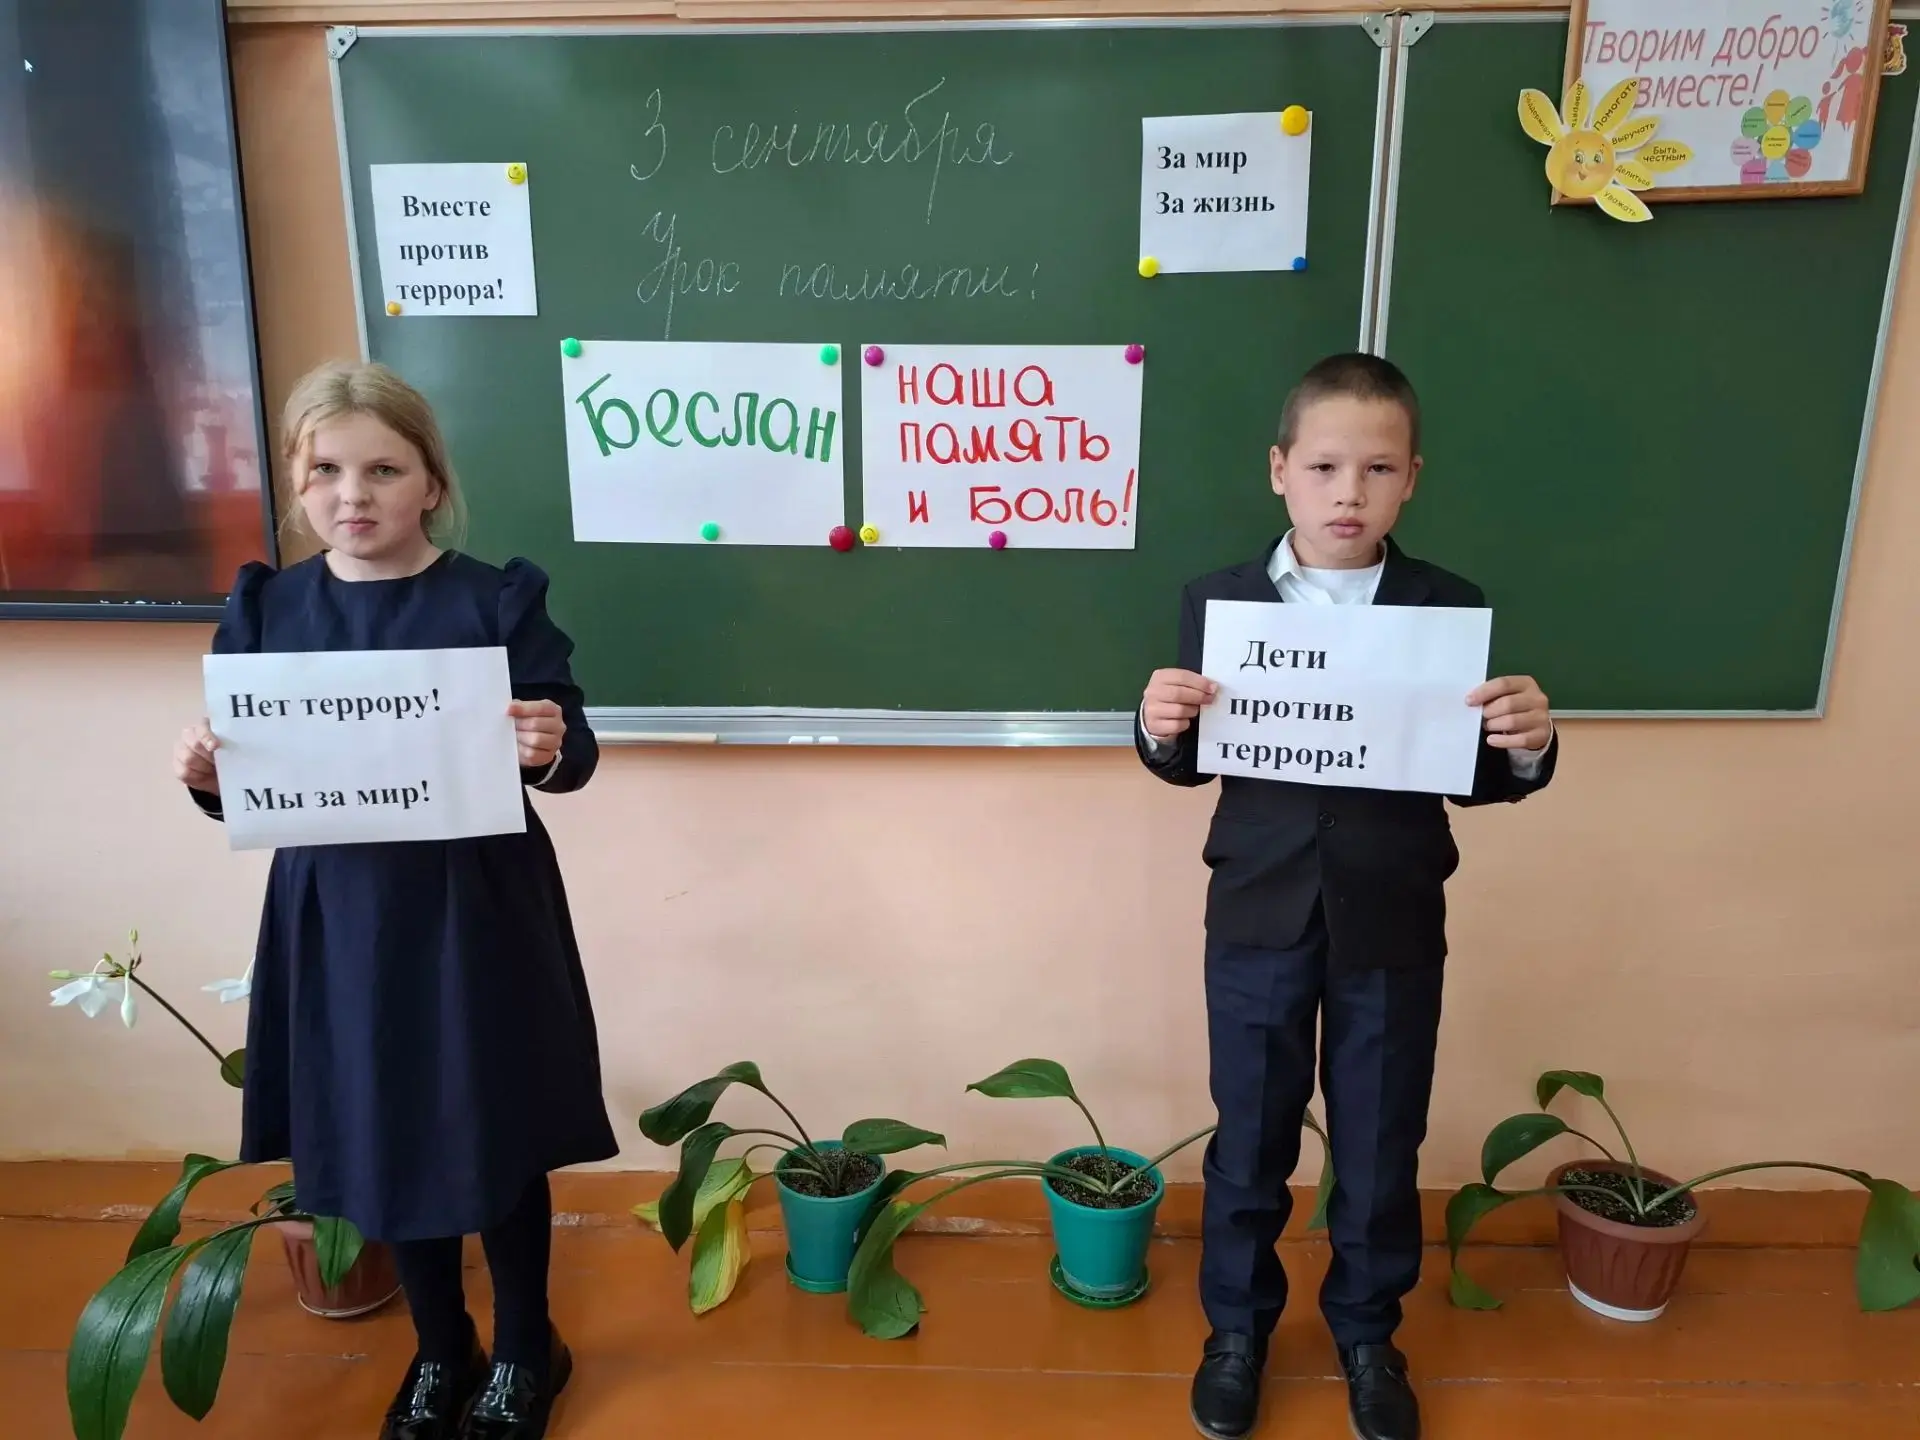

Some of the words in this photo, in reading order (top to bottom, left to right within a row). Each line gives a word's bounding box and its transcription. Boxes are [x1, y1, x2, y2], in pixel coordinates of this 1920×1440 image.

[1584, 20, 1706, 74] Творим
[1711, 14, 1820, 70] добро
[1633, 63, 1765, 109] вместе!
[1592, 80, 1638, 132] Помогать
[630, 88, 668, 180] 3
[712, 76, 1014, 225] сентября
[1156, 145, 1187, 170] За
[1195, 151, 1248, 175] мир
[1642, 153, 1687, 163] честным
[1652, 145, 1677, 155] Быть
[1615, 164, 1651, 187] Делиться
[401, 195, 491, 217] Вместе
[1155, 191, 1185, 215] За
[1193, 196, 1276, 214] жизнь
[399, 244, 489, 266] против
[396, 278, 504, 306] террора!
[636, 211, 741, 342] Урок
[575, 373, 837, 463] Беслан
[1239, 640, 1327, 674] Дети
[229, 693, 291, 719] Нет
[300, 688, 442, 721] террору!
[1229, 698, 1354, 723] против
[1217, 740, 1368, 773] террора!
[242, 786, 305, 812] Мы
[314, 790, 347, 808] за
[356, 780, 431, 810] мир!
